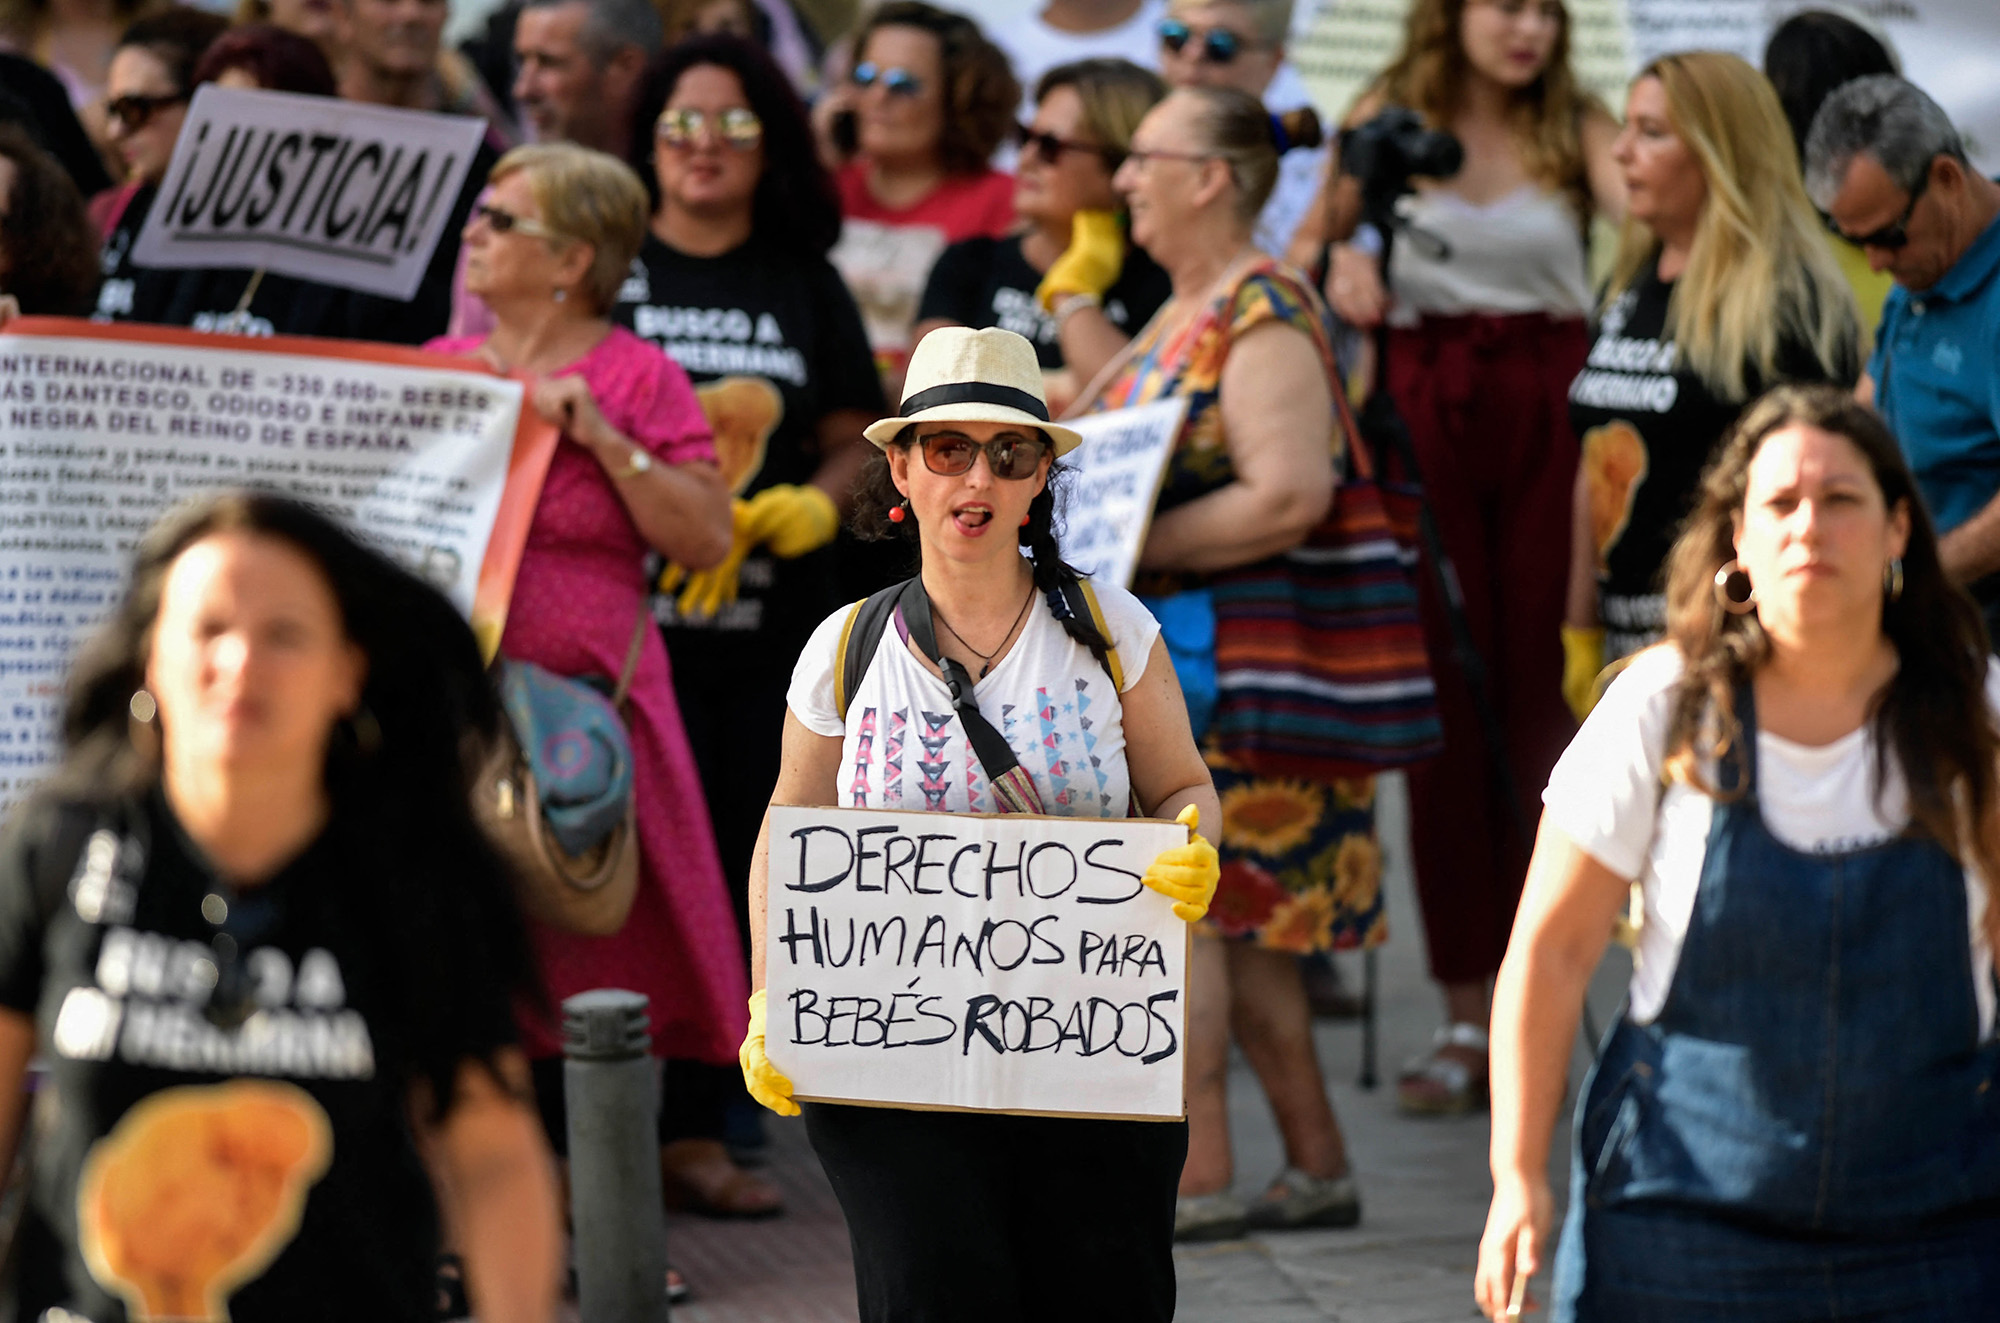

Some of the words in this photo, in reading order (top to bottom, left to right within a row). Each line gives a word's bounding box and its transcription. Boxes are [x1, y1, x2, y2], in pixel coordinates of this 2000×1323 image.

[164, 121, 456, 254] ¡JUSTICIA!
[755, 312, 785, 345] A
[221, 366, 254, 390] DE
[11, 408, 98, 432] NEGRA
[107, 411, 159, 436] DEL
[169, 415, 252, 443] REINO
[260, 423, 294, 449] DE
[208, 391, 312, 424] ODIOSO
[322, 403, 335, 425] E
[346, 406, 446, 433] INFAME
[785, 824, 1144, 904] DERECHOS
[779, 906, 1065, 977] HUMANOS
[1079, 929, 1167, 977] PARA
[788, 976, 957, 1049] BEBÉS
[962, 989, 1179, 1065] ROBADOS
